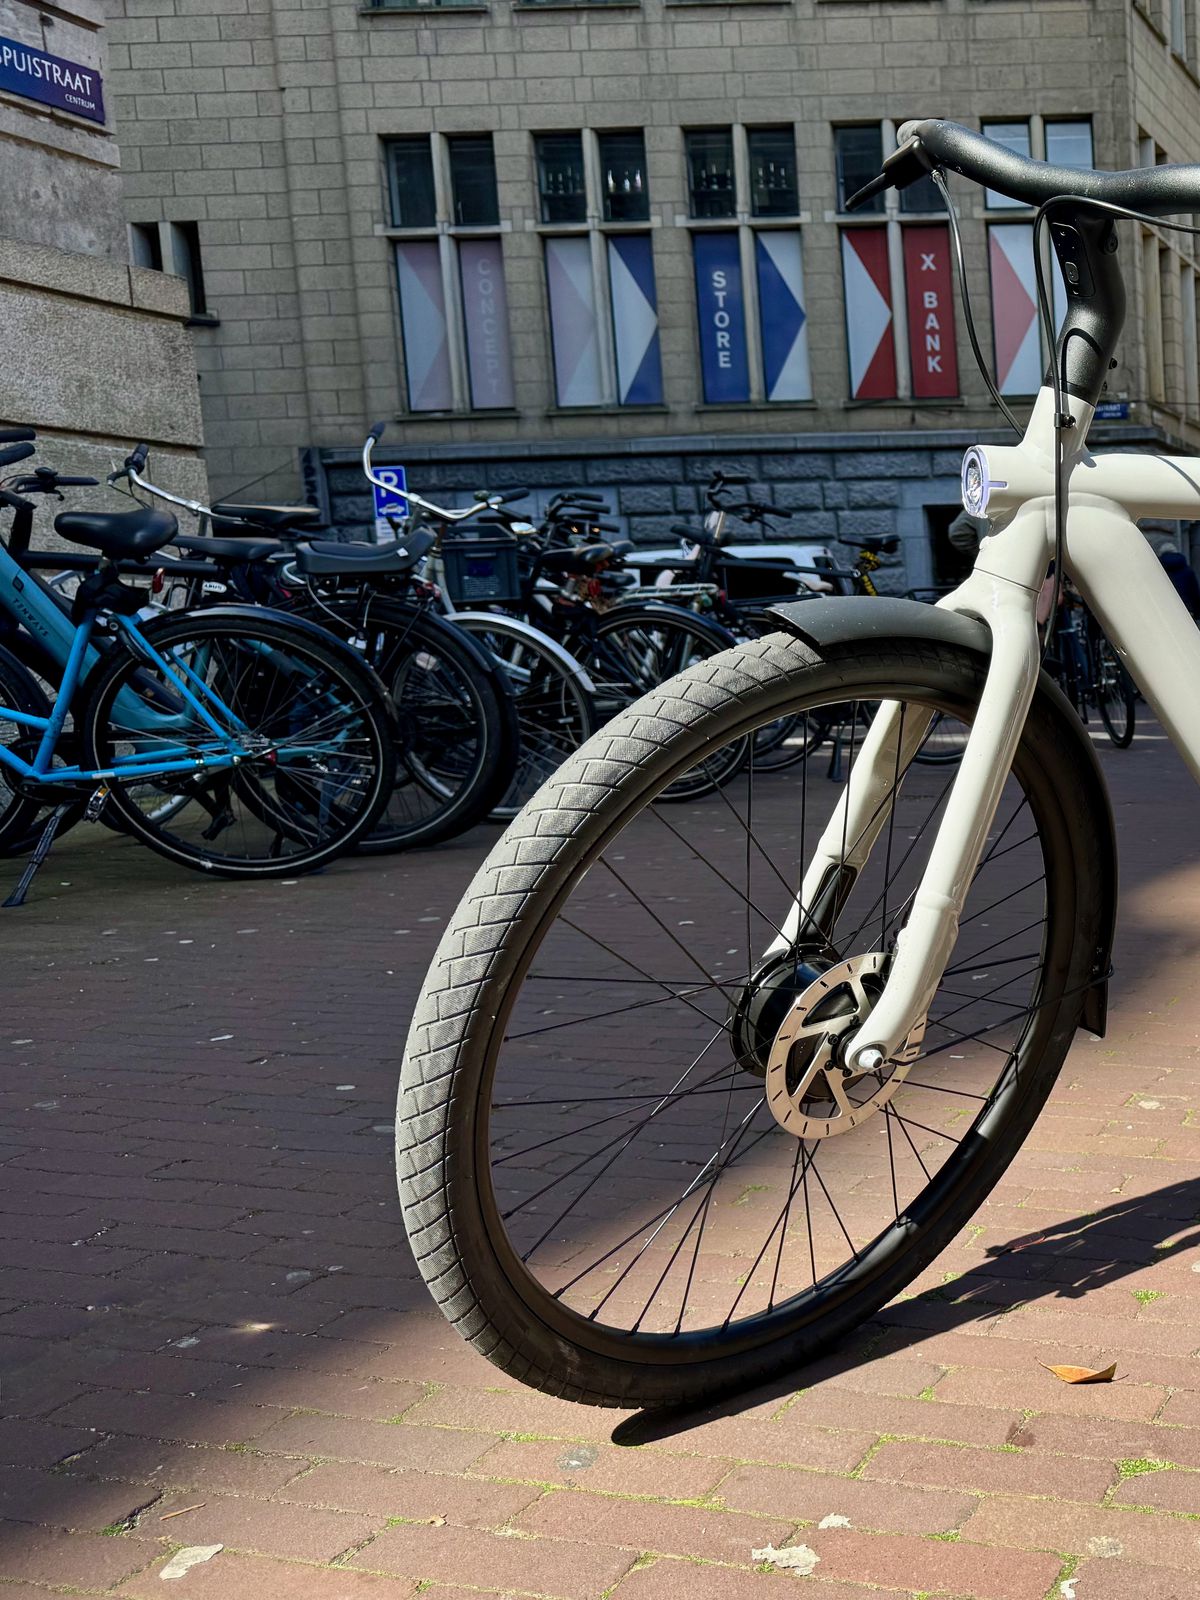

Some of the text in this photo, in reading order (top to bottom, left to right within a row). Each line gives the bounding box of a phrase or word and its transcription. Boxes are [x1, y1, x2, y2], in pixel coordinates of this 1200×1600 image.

[0, 45, 92, 95] PUISTRAAT
[64, 93, 96, 111] CENTRUM
[477, 258, 500, 394] CONCEPT
[712, 269, 731, 368] STORE
[920, 253, 942, 373] X BANK
[379, 471, 398, 498] P
